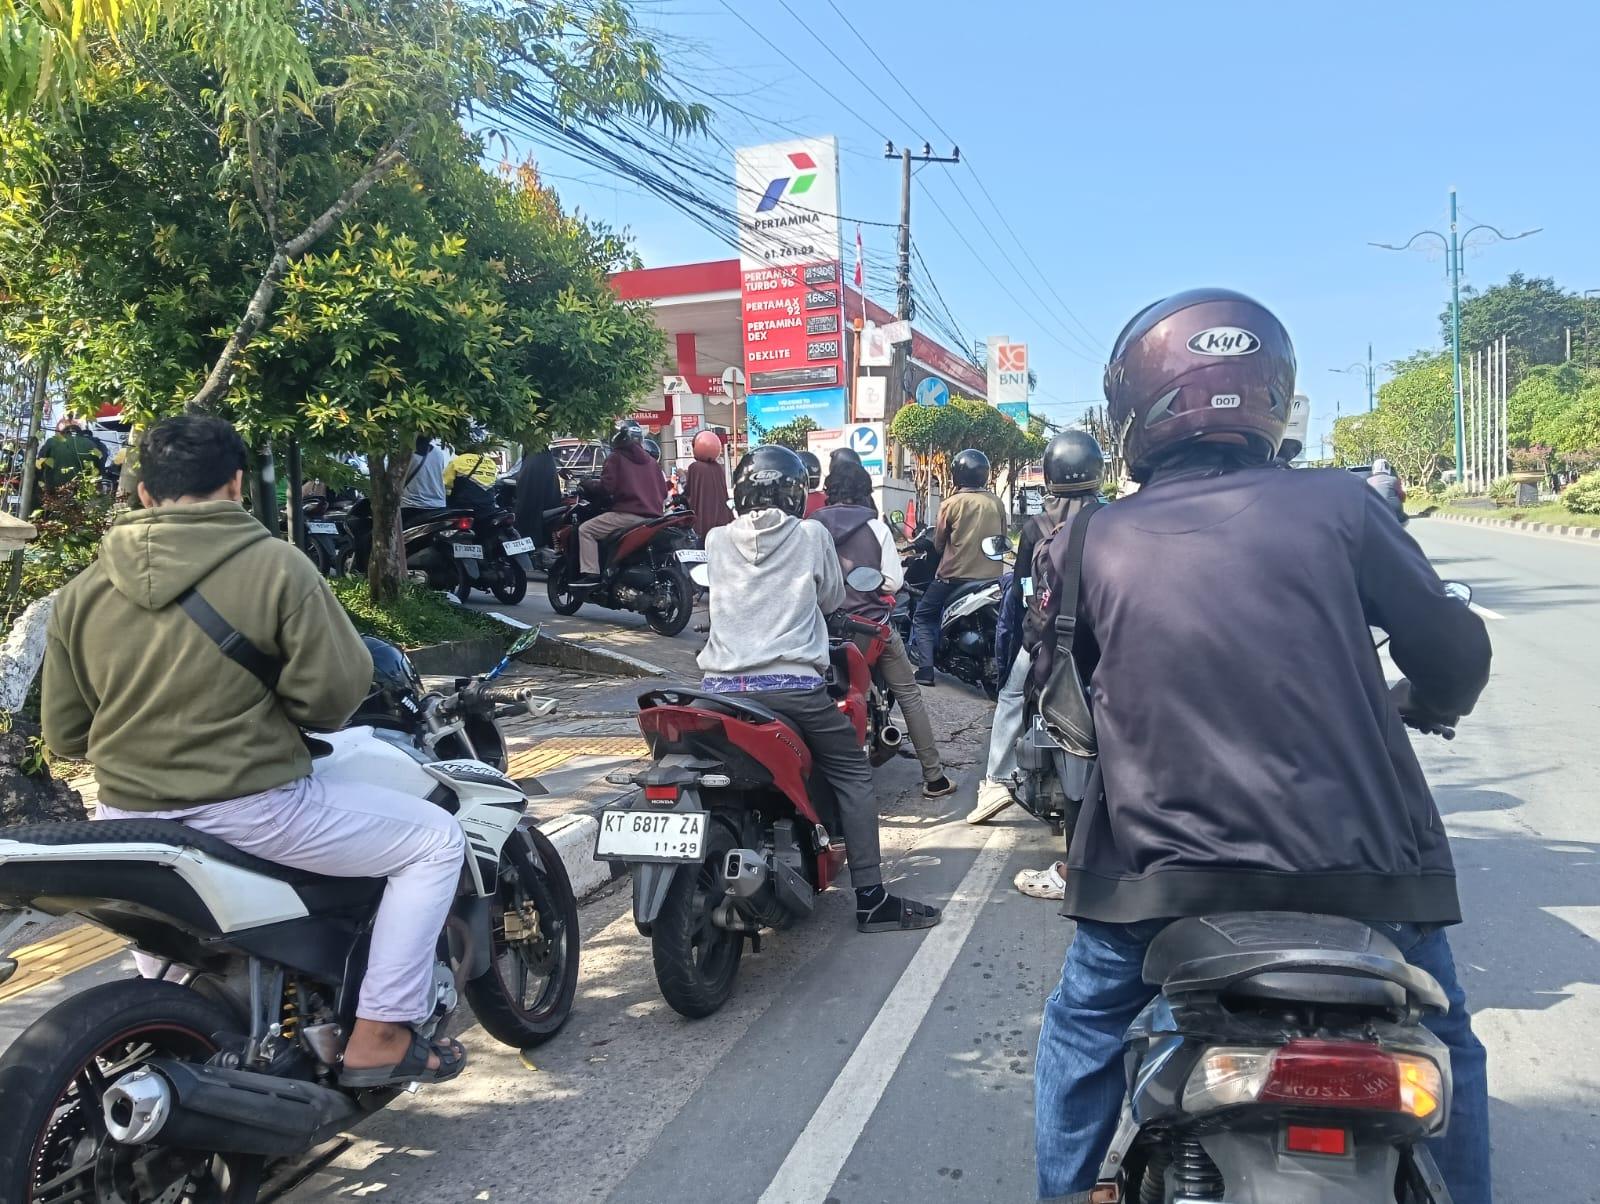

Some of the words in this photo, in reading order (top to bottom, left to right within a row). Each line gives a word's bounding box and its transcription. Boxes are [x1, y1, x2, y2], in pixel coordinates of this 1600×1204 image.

[755, 213, 820, 230] PERTAMINA
[745, 280, 778, 291] TURBO
[746, 298, 799, 311] PERTAMAX
[786, 306, 801, 316] 92
[748, 317, 802, 331] PERTAMINA
[748, 331, 767, 342] DEX
[808, 342, 836, 354] 23500
[748, 349, 791, 361] DEXLITE
[1000, 373, 1024, 385] BNI
[1215, 397, 1236, 406] DOT
[604, 815, 625, 833] KT
[632, 815, 670, 833] 6817
[679, 817, 699, 835] ZA
